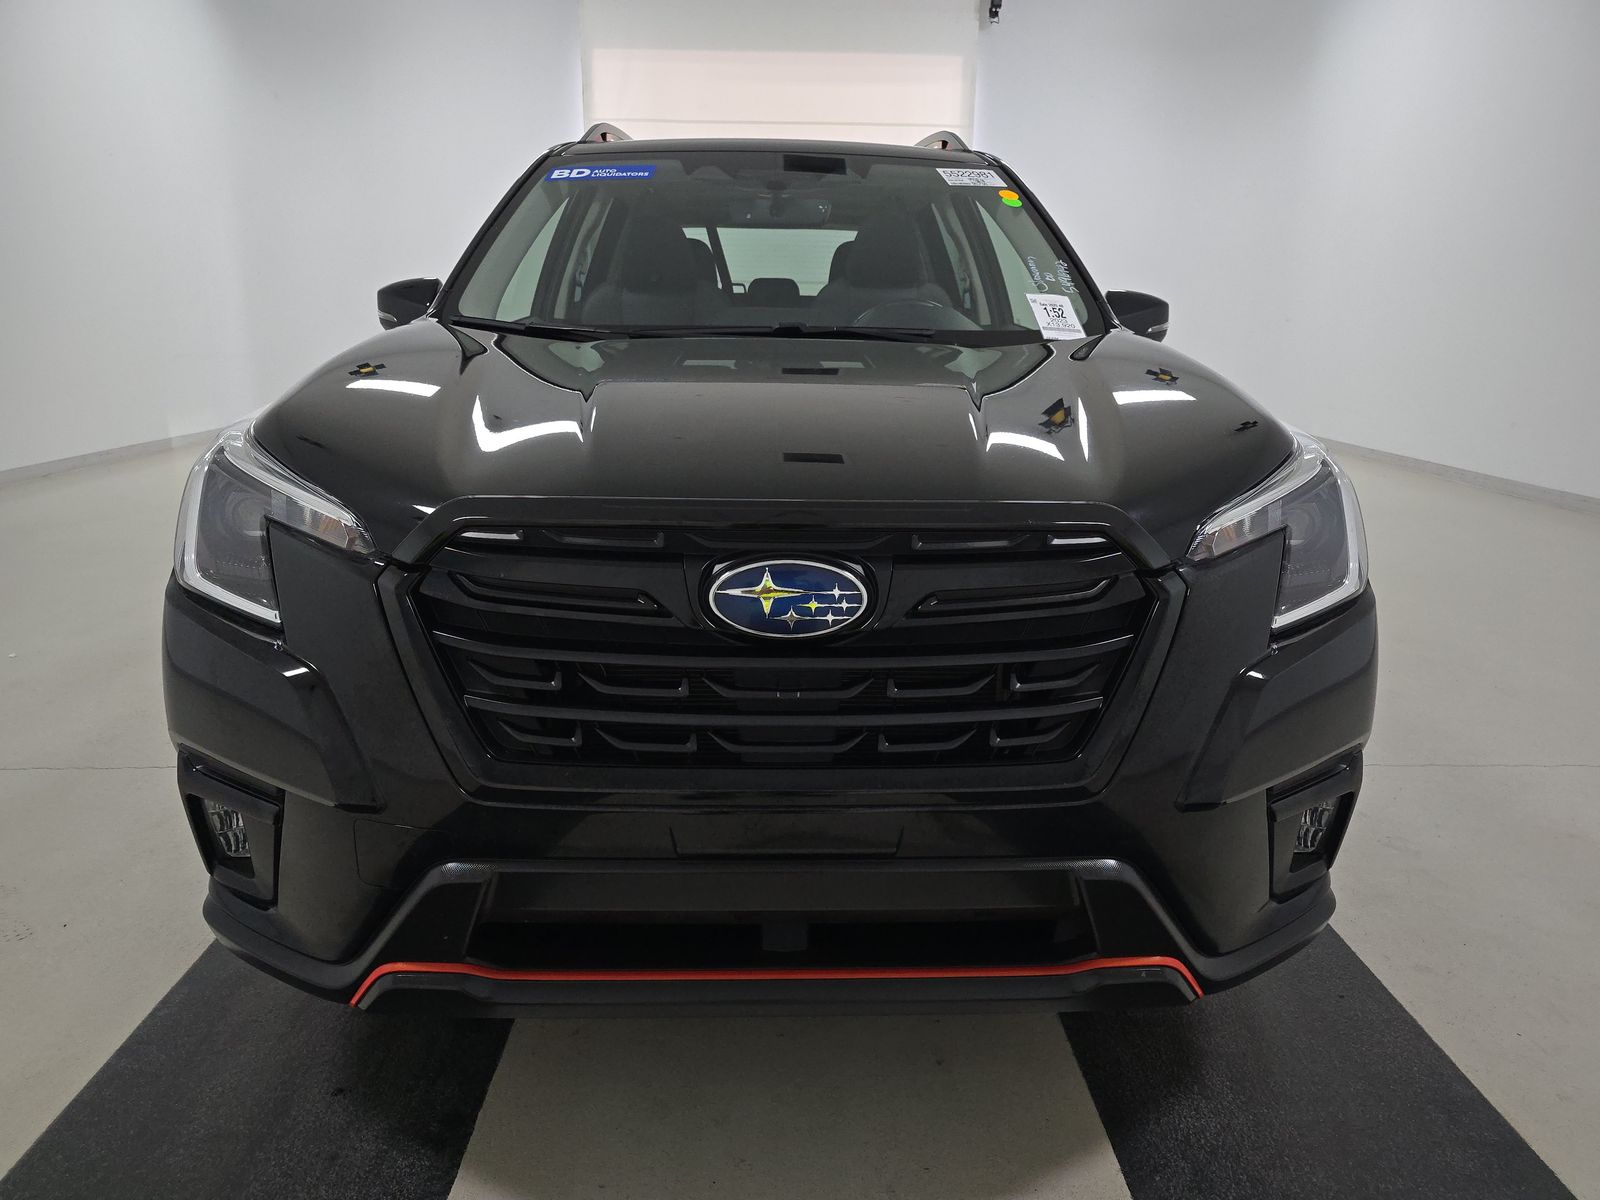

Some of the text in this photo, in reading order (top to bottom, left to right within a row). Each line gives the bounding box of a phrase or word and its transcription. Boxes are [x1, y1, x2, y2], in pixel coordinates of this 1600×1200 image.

[551, 168, 591, 179] BD
[942, 170, 995, 179] 5522981
[1044, 307, 1067, 319] 1:52
